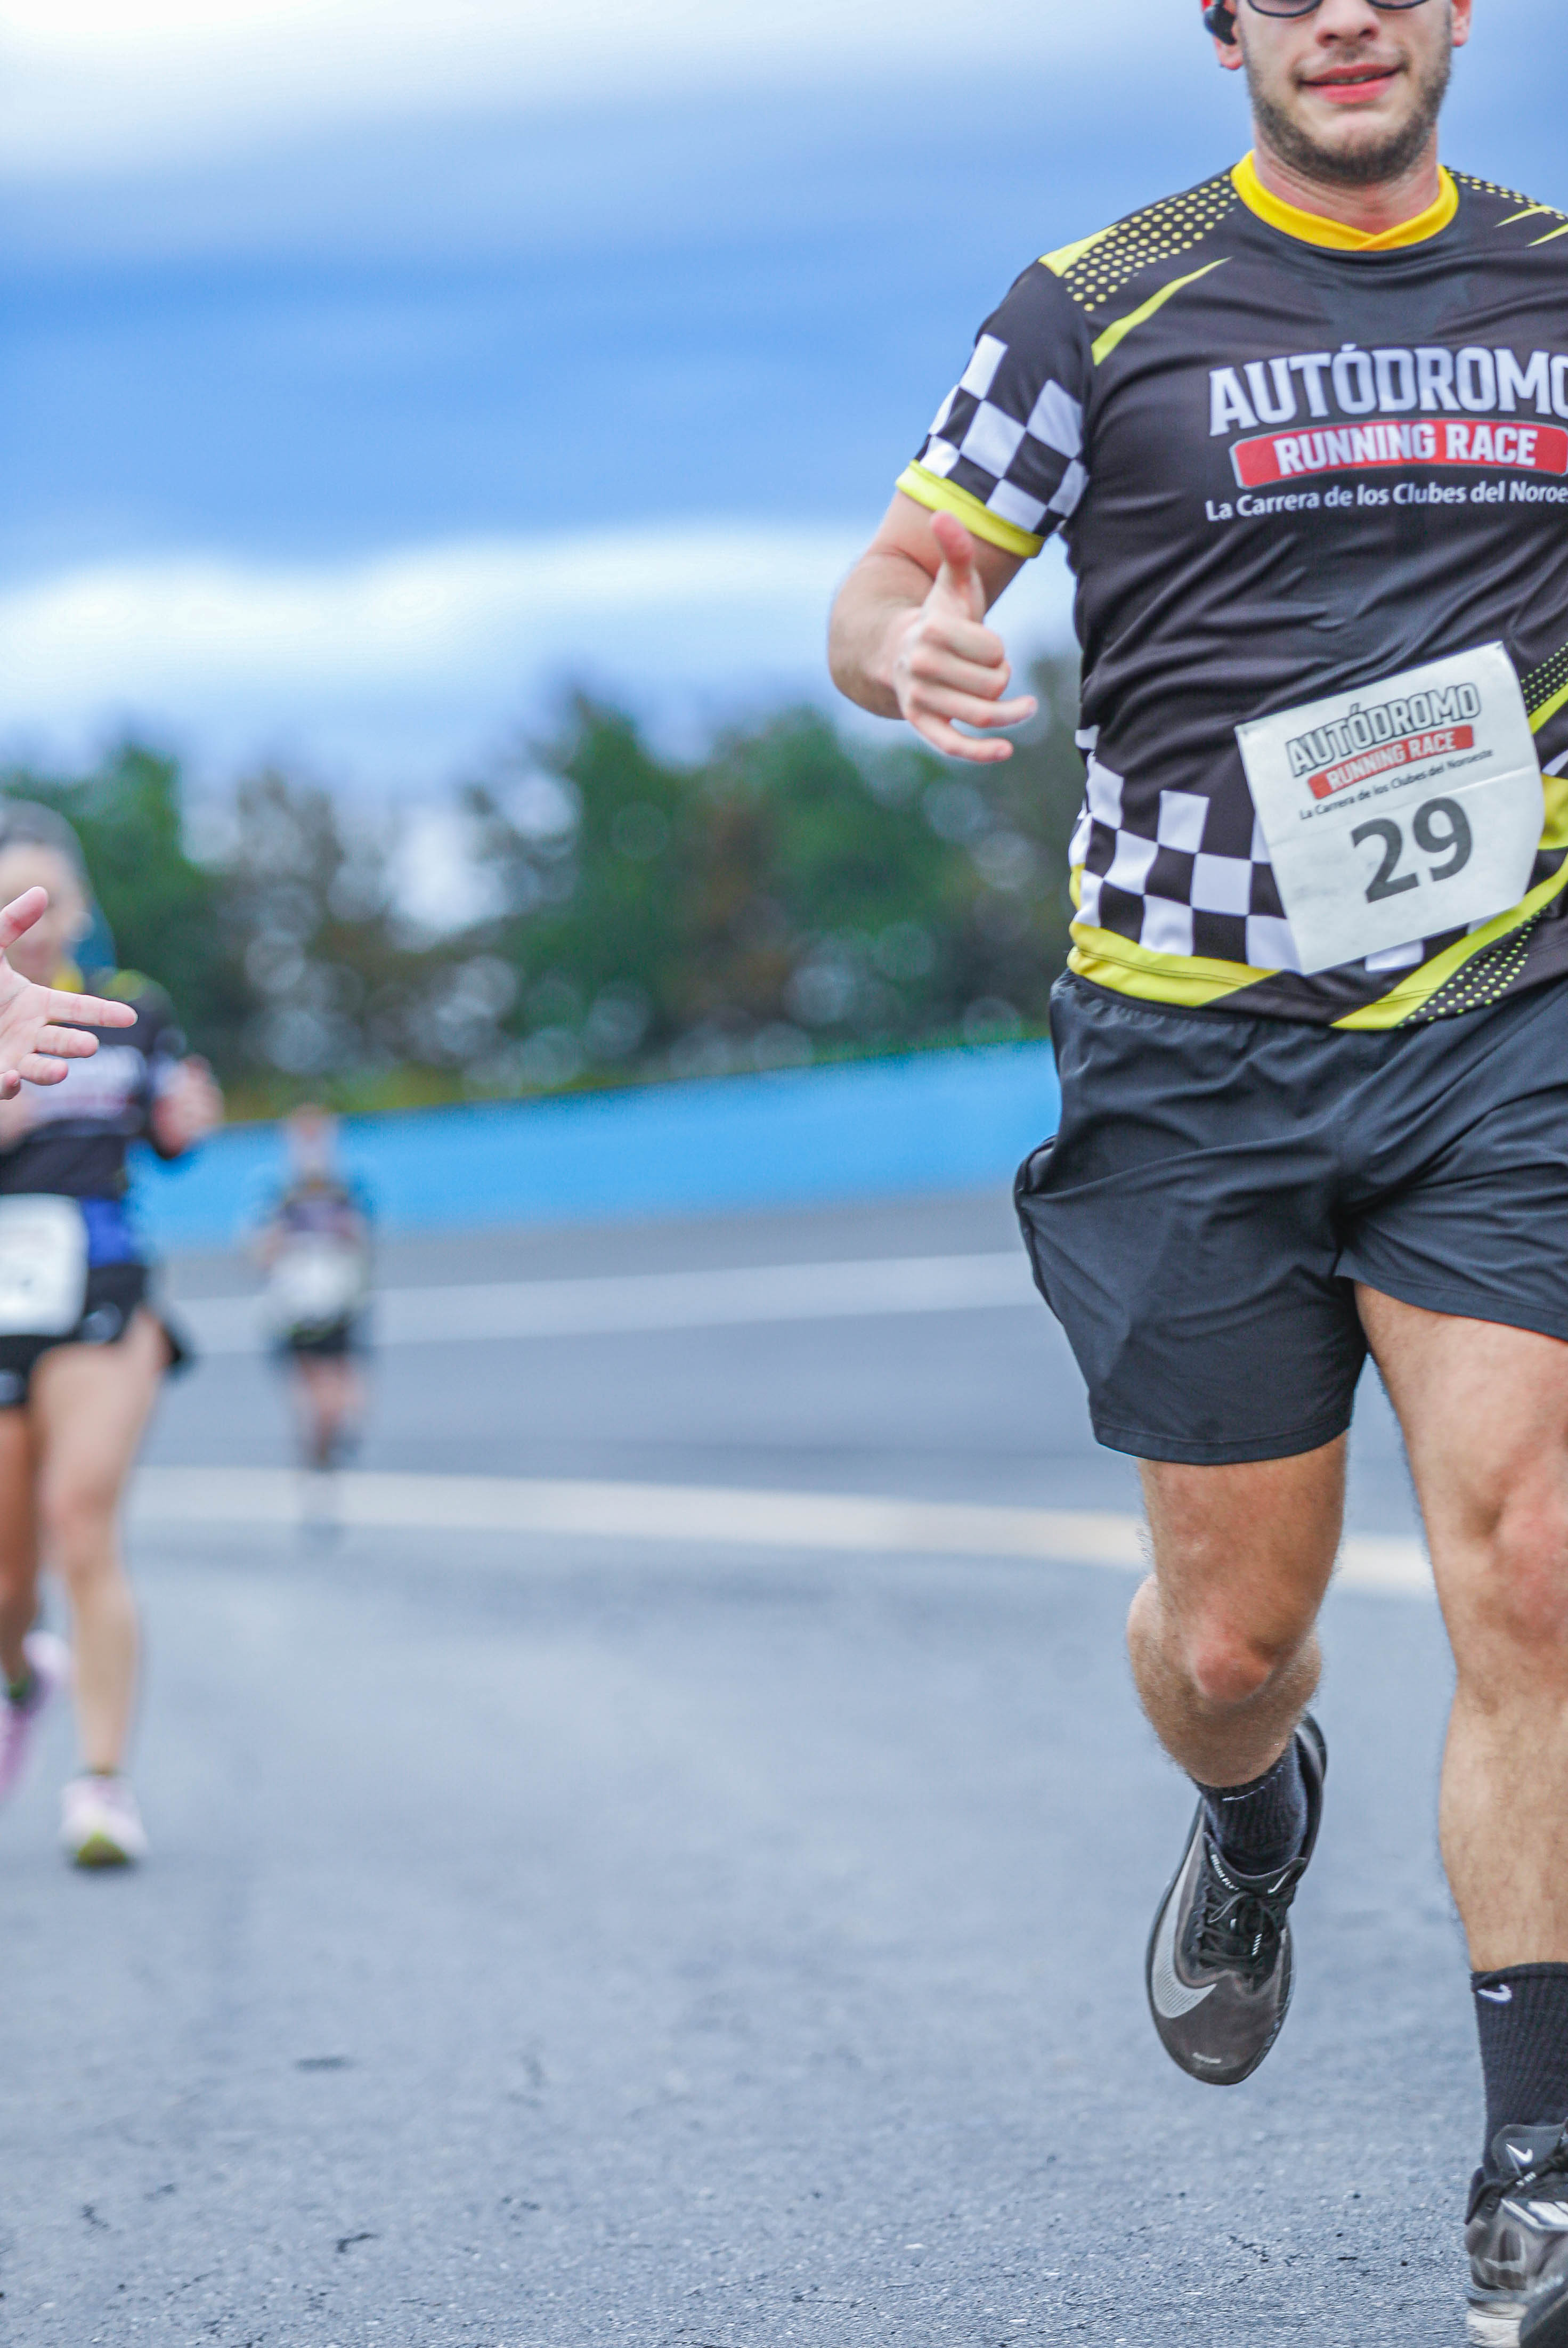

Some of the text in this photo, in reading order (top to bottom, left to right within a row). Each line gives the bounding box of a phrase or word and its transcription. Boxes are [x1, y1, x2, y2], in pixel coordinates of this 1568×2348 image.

[1273, 424, 1538, 475] RUNNING RACE
[1205, 480, 1568, 522] La Carrera de los Clubes del Noroe
[1285, 683, 1481, 778] AUTÓDROMO
[1326, 730, 1457, 791] RUNNING RACE
[1298, 808, 1313, 820] La
[1314, 796, 1355, 815] Carrera
[1357, 789, 1371, 800] de
[1372, 784, 1388, 795] los
[1391, 771, 1427, 789] Clubes
[1428, 761, 1444, 776] del
[1350, 797, 1473, 904] 29
